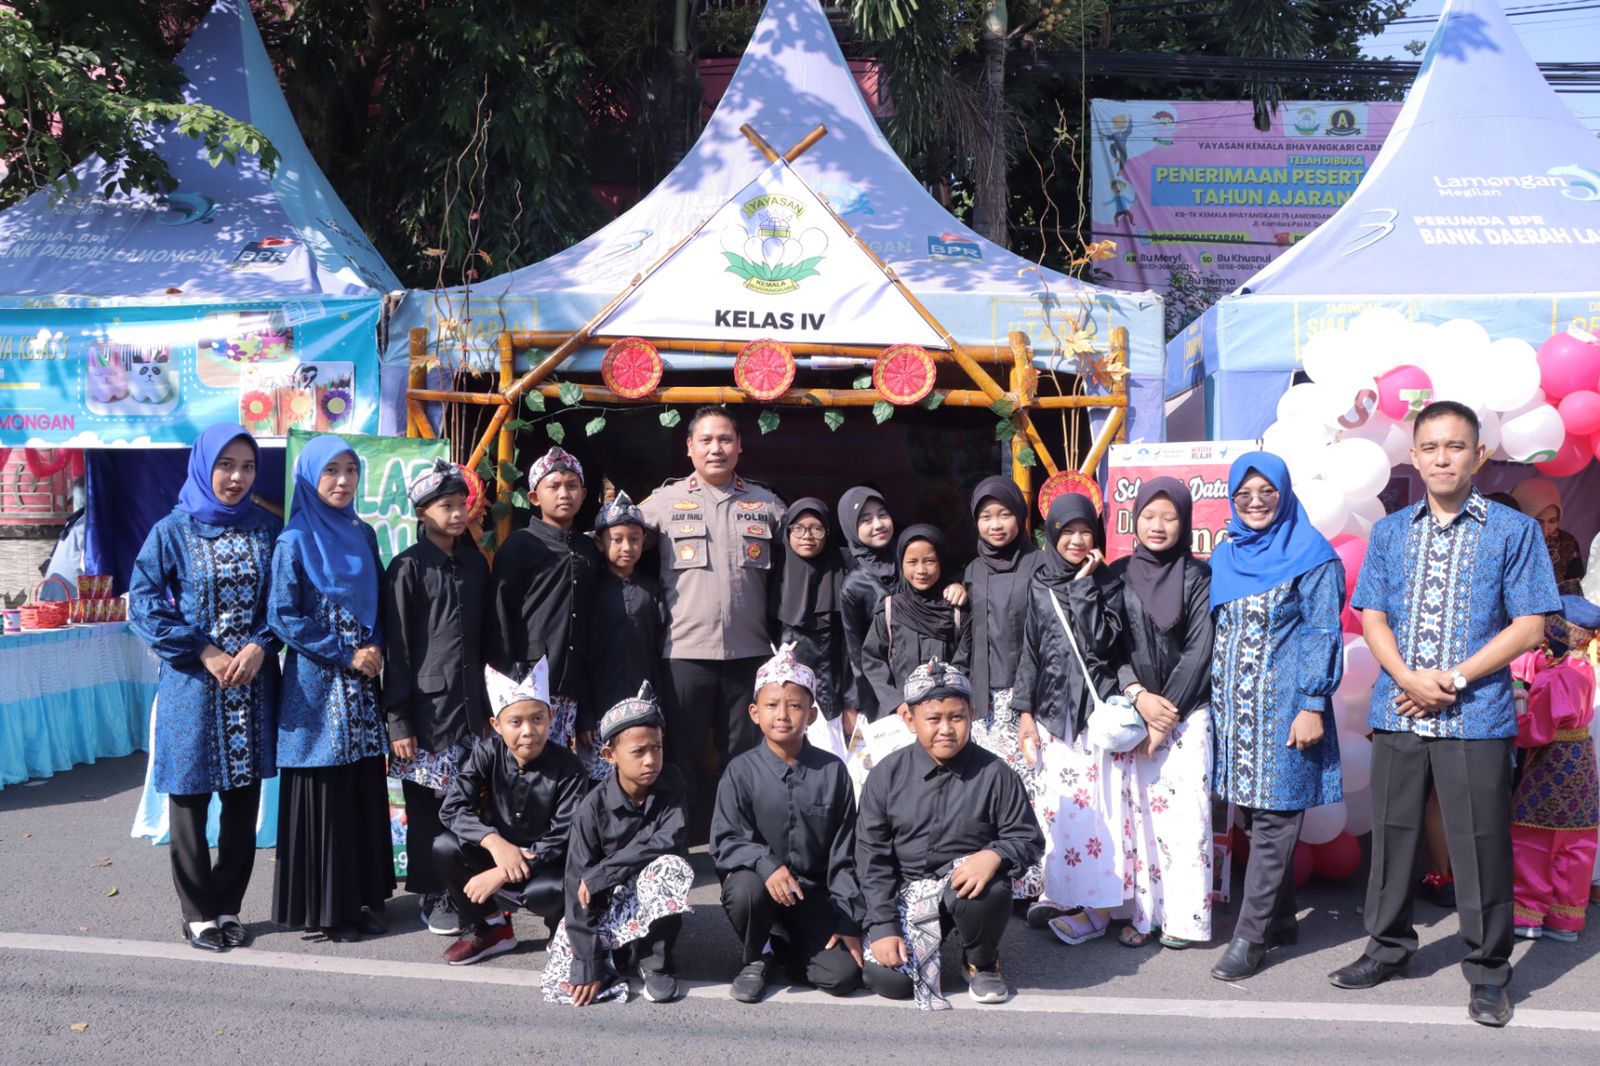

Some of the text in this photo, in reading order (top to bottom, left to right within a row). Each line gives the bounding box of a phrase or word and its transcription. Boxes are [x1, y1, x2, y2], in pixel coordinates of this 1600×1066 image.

[1198, 142, 1245, 150] YAYASAN
[1246, 143, 1284, 151] KEMALA
[1286, 143, 1356, 152] BHAYANGKARI
[1289, 156, 1363, 167] TELAH DIBUKA
[1155, 167, 1288, 185] PENERIMAAN
[1432, 174, 1568, 190] Lamongan
[1192, 188, 1264, 206] TAHUN
[1438, 188, 1502, 199] Megilan
[750, 196, 803, 214] YAYASAN
[1199, 211, 1228, 219] KEMALA
[1228, 211, 1280, 220] BHAYANGKARI
[1412, 215, 1546, 226] PERUMDA BPR
[1418, 228, 1483, 245] BANK
[1483, 228, 1574, 245] DAERAH
[38, 244, 113, 260] DAERAH
[112, 248, 225, 264] LAMONGAN
[238, 250, 288, 263] BPR
[931, 244, 978, 257] BPR
[1140, 254, 1152, 263] Bu
[1217, 254, 1272, 264] Bu Khusnul
[715, 309, 826, 331] KELAS IV
[736, 513, 769, 521] POLRI
